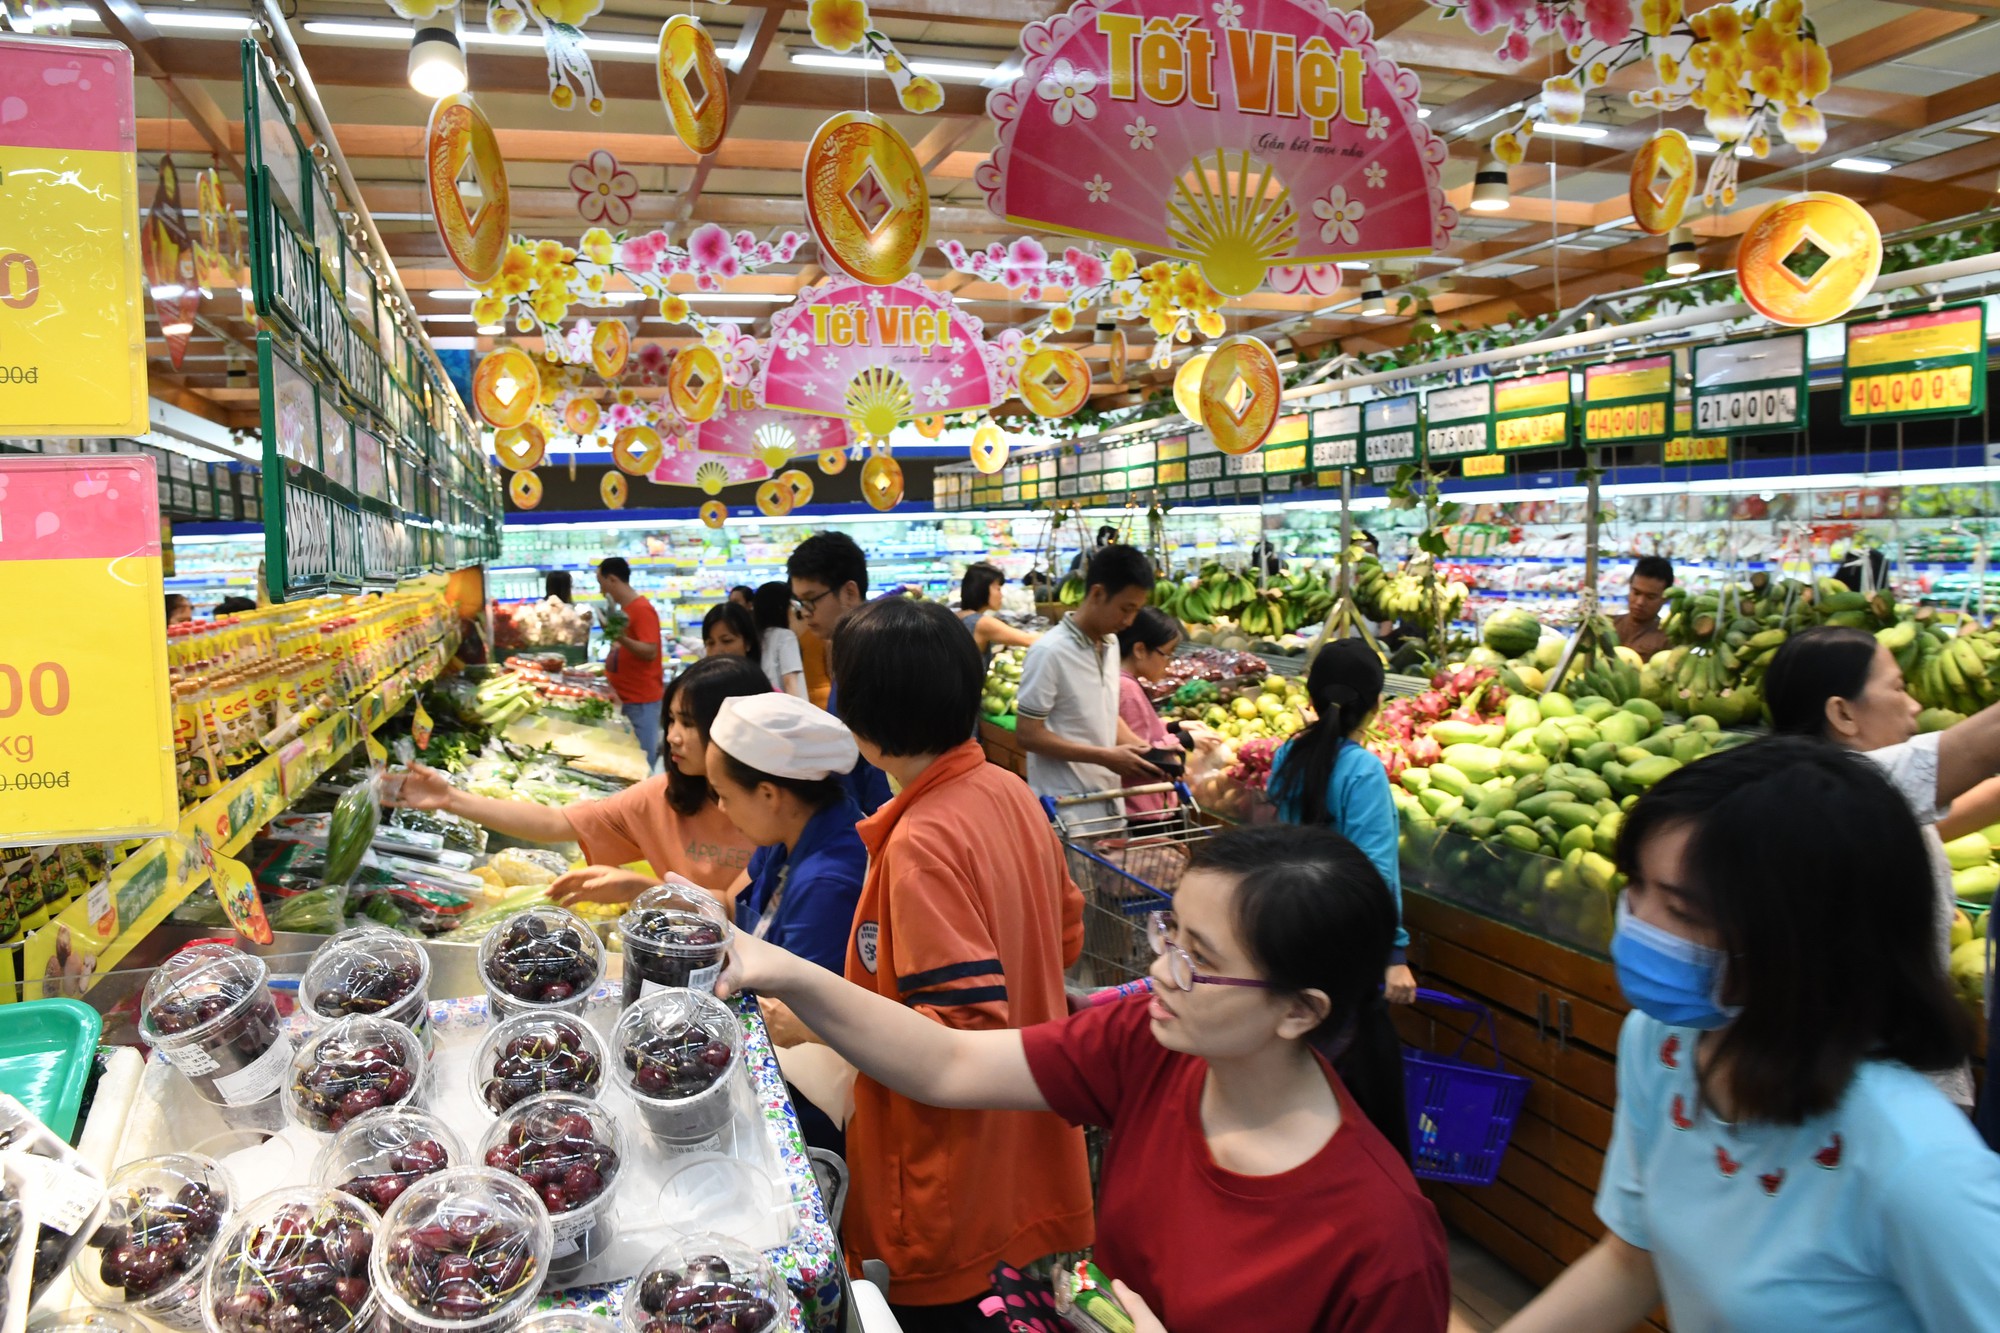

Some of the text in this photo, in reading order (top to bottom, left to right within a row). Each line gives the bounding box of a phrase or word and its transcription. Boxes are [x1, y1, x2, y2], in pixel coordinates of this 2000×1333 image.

[1097, 12, 1368, 140] Tết Việt
[808, 302, 953, 357] Tết Việt
[1700, 395, 1776, 423] 21.000
[1855, 374, 1944, 407] 40.000
